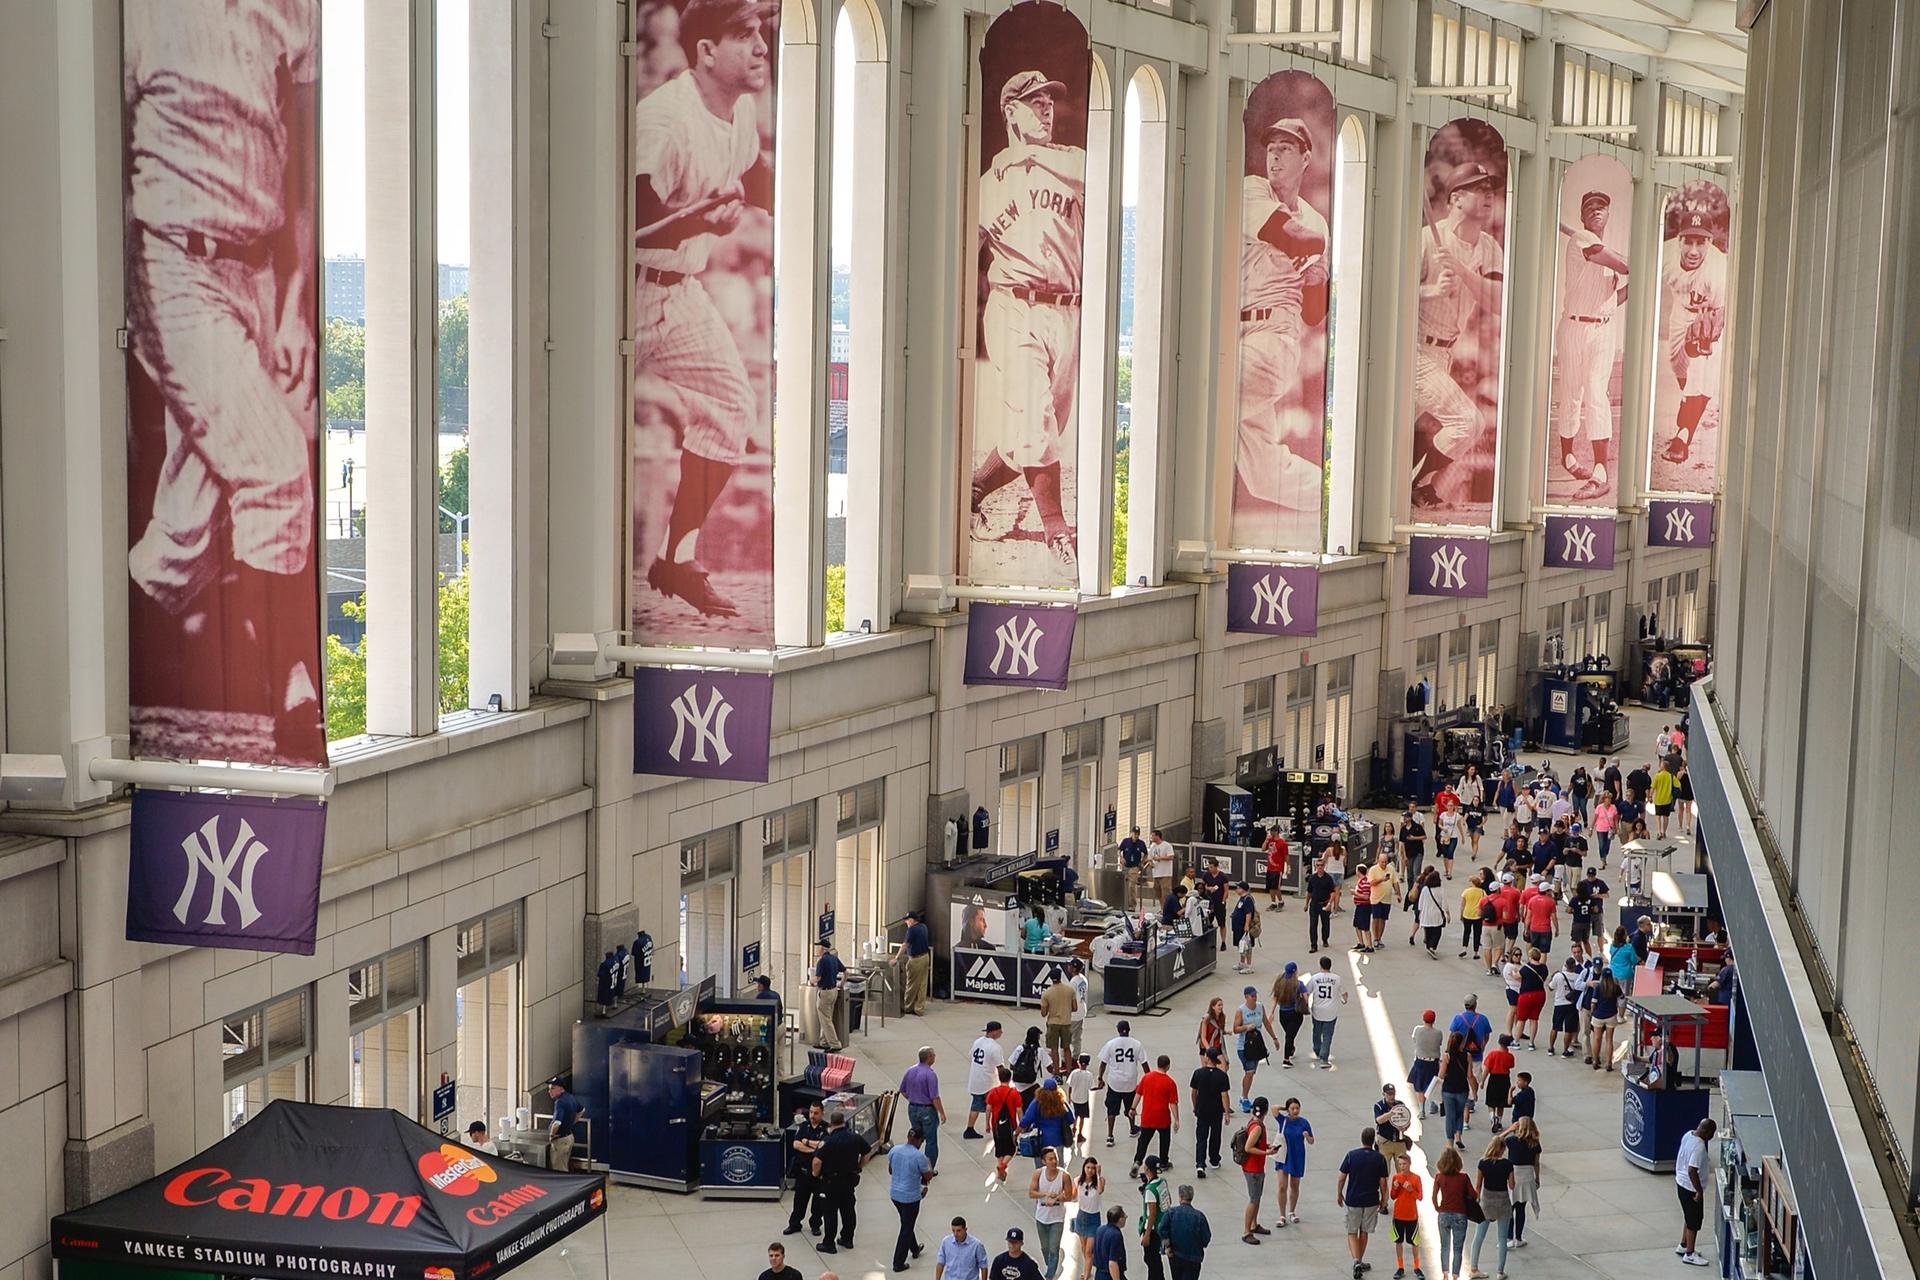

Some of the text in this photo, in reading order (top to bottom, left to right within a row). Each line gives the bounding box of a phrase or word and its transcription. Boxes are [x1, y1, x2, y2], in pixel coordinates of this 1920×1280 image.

[988, 199, 1021, 240] NEW
[1561, 523, 1597, 563] NY
[1664, 507, 1695, 542] NY
[1429, 544, 1468, 590] NY
[989, 615, 1044, 676] NY
[668, 683, 734, 766] NY
[172, 814, 269, 930] NY
[965, 979, 1006, 992] Majestic
[1318, 986, 1332, 998] 51
[1115, 1047, 1135, 1063] 24
[163, 1167, 422, 1228] Canon
[466, 1183, 548, 1226] Canon
[496, 1241, 520, 1264] YANKEE
[545, 1199, 587, 1236] PHOTOGRAPHY
[124, 1240, 397, 1279] YANKEE STADIUM PHOTOGRAPHY
